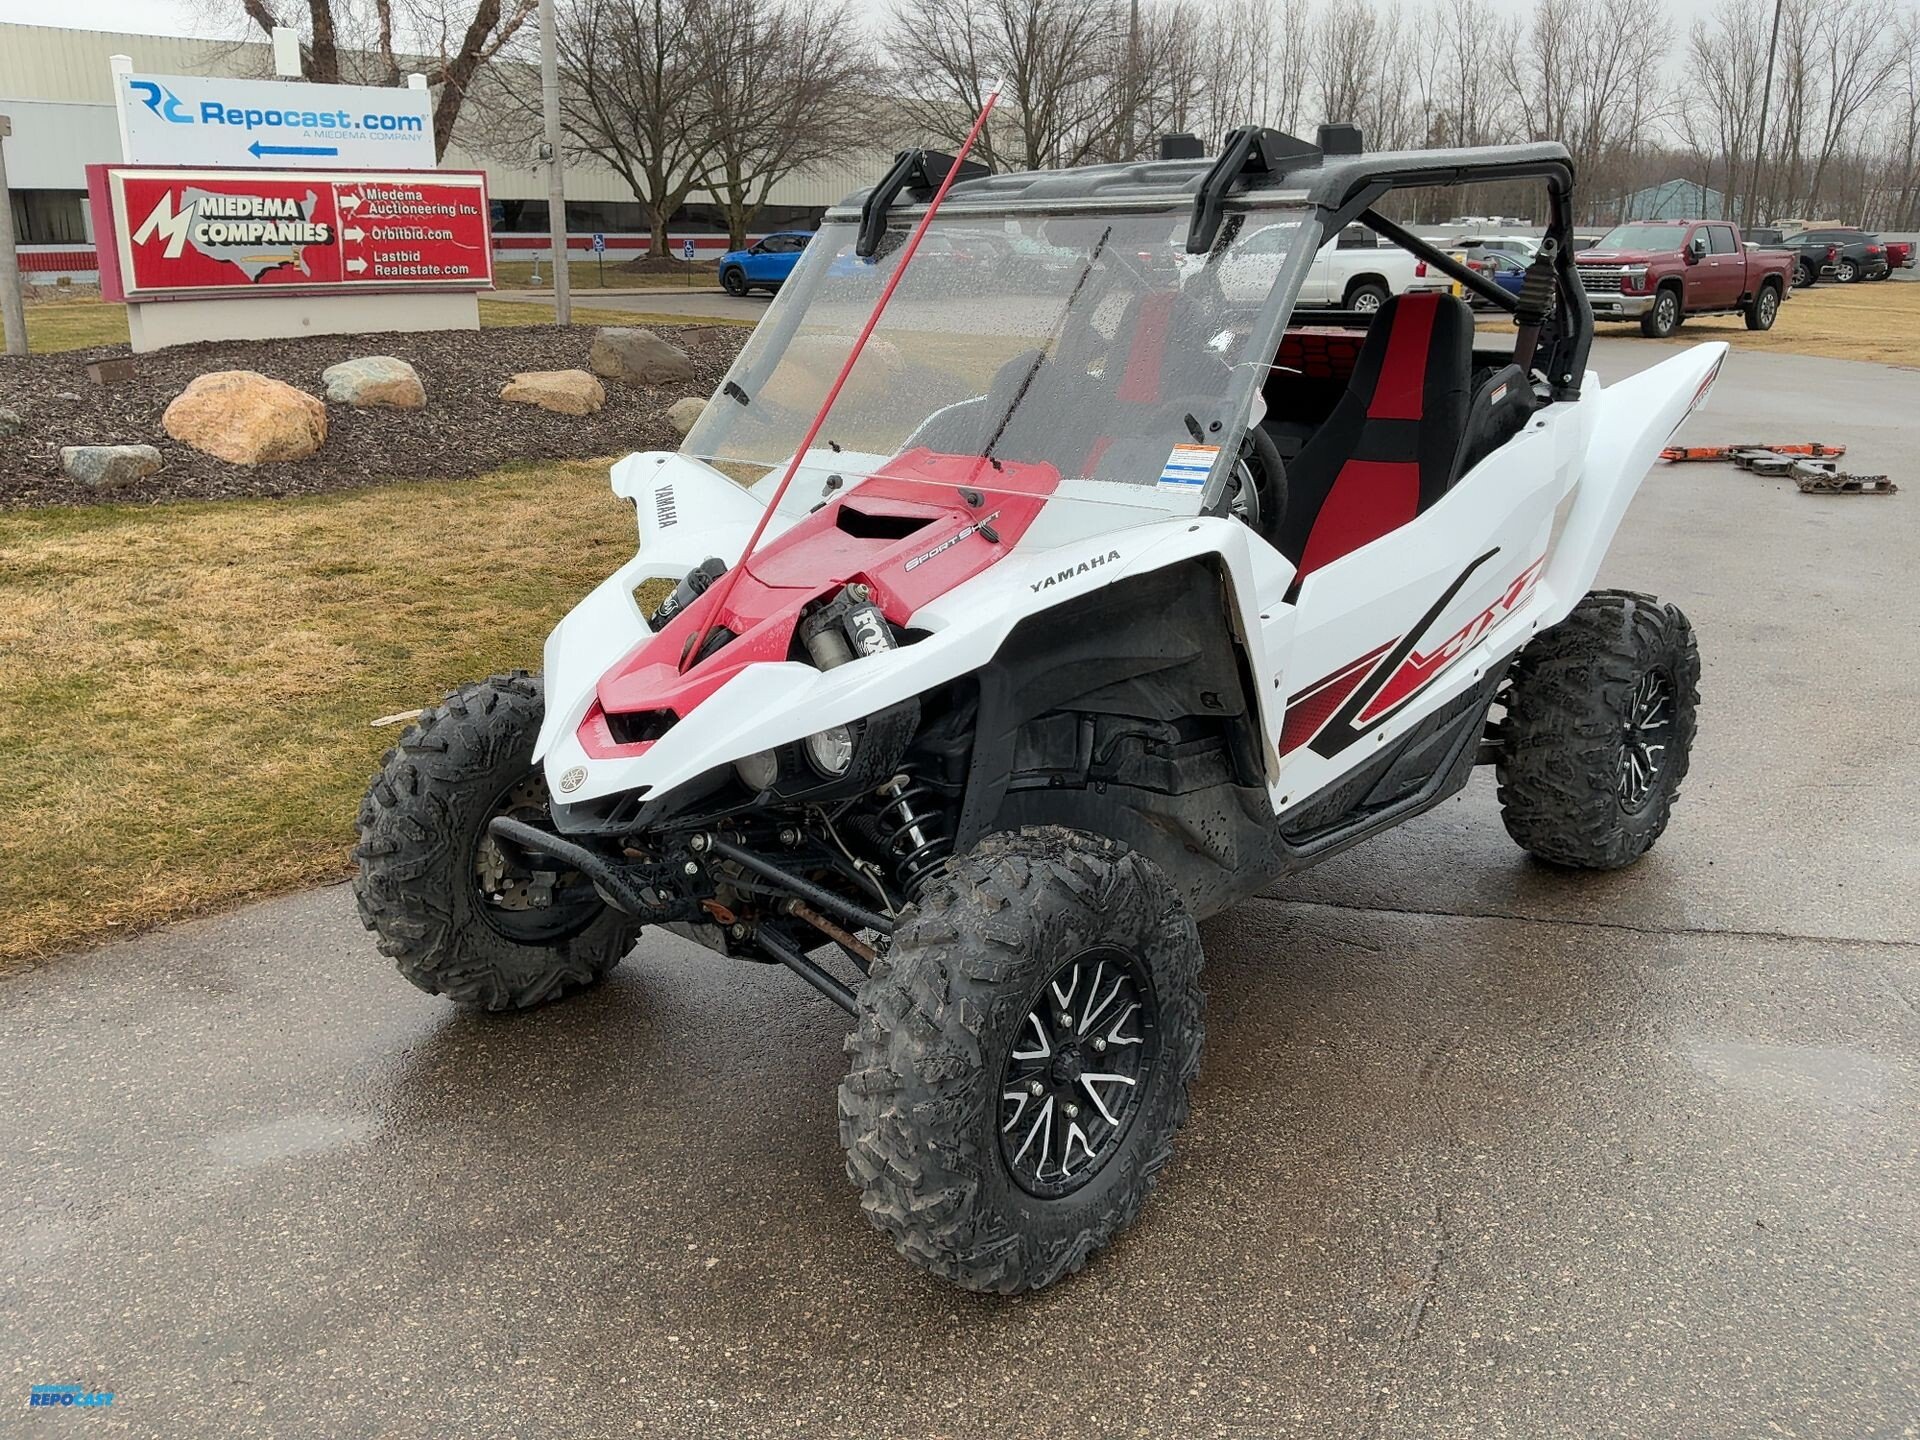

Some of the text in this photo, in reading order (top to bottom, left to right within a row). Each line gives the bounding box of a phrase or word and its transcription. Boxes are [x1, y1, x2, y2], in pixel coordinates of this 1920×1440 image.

[200, 102, 422, 130] Repocast.com
[314, 131, 367, 140] MIEDEMA
[369, 133, 423, 141] COMPANY
[366, 189, 423, 201] Miedema
[199, 197, 300, 219] MIEDEMA
[369, 203, 456, 217] Auctioneering
[194, 223, 330, 244] COMPANIES
[371, 229, 453, 241] Orbitbid.com
[373, 251, 421, 262] Lastbid
[374, 264, 469, 276] Realestate.com
[654, 484, 678, 529] YAMAHA
[1030, 550, 1121, 593] YAMAHA
